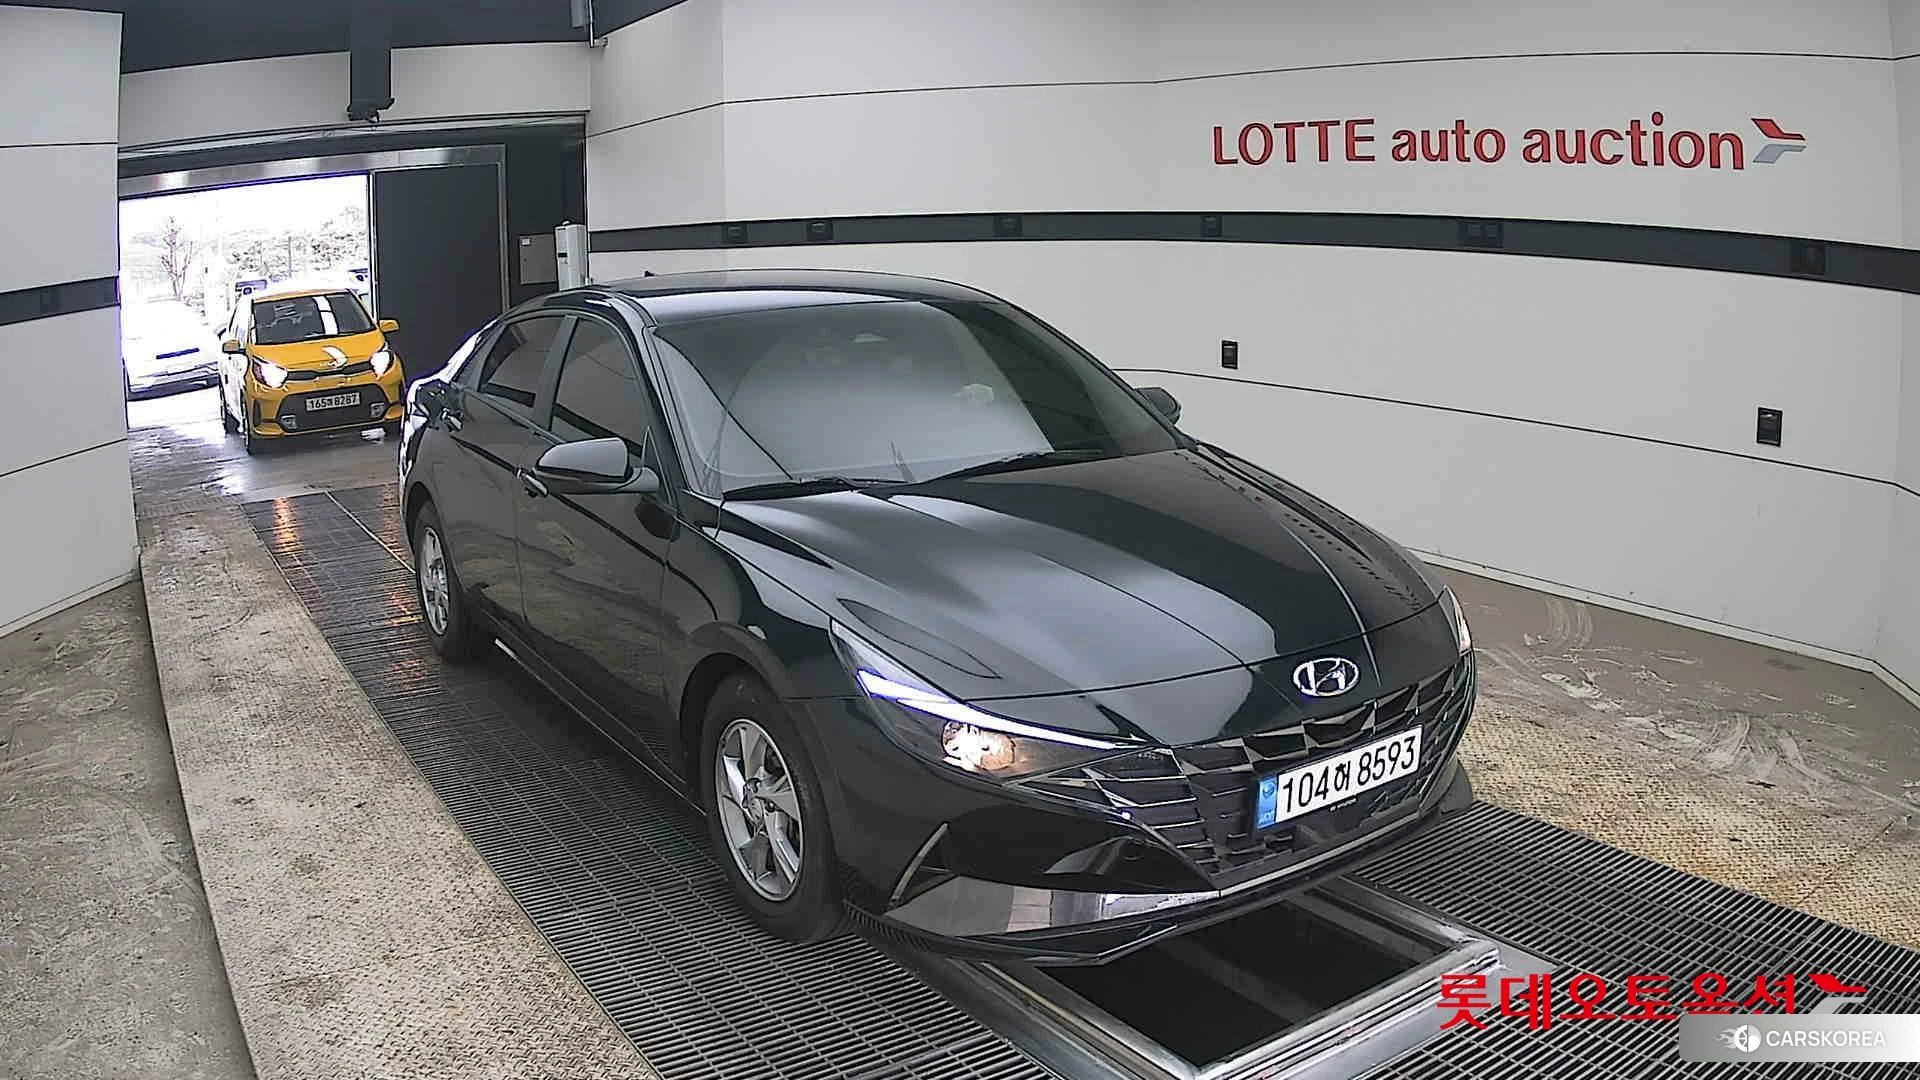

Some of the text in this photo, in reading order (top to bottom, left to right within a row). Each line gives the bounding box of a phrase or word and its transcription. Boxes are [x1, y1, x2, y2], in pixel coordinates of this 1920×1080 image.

[1212, 110, 1744, 170] LOTTE auto auction
[1282, 735, 1416, 813] 104허 8593
